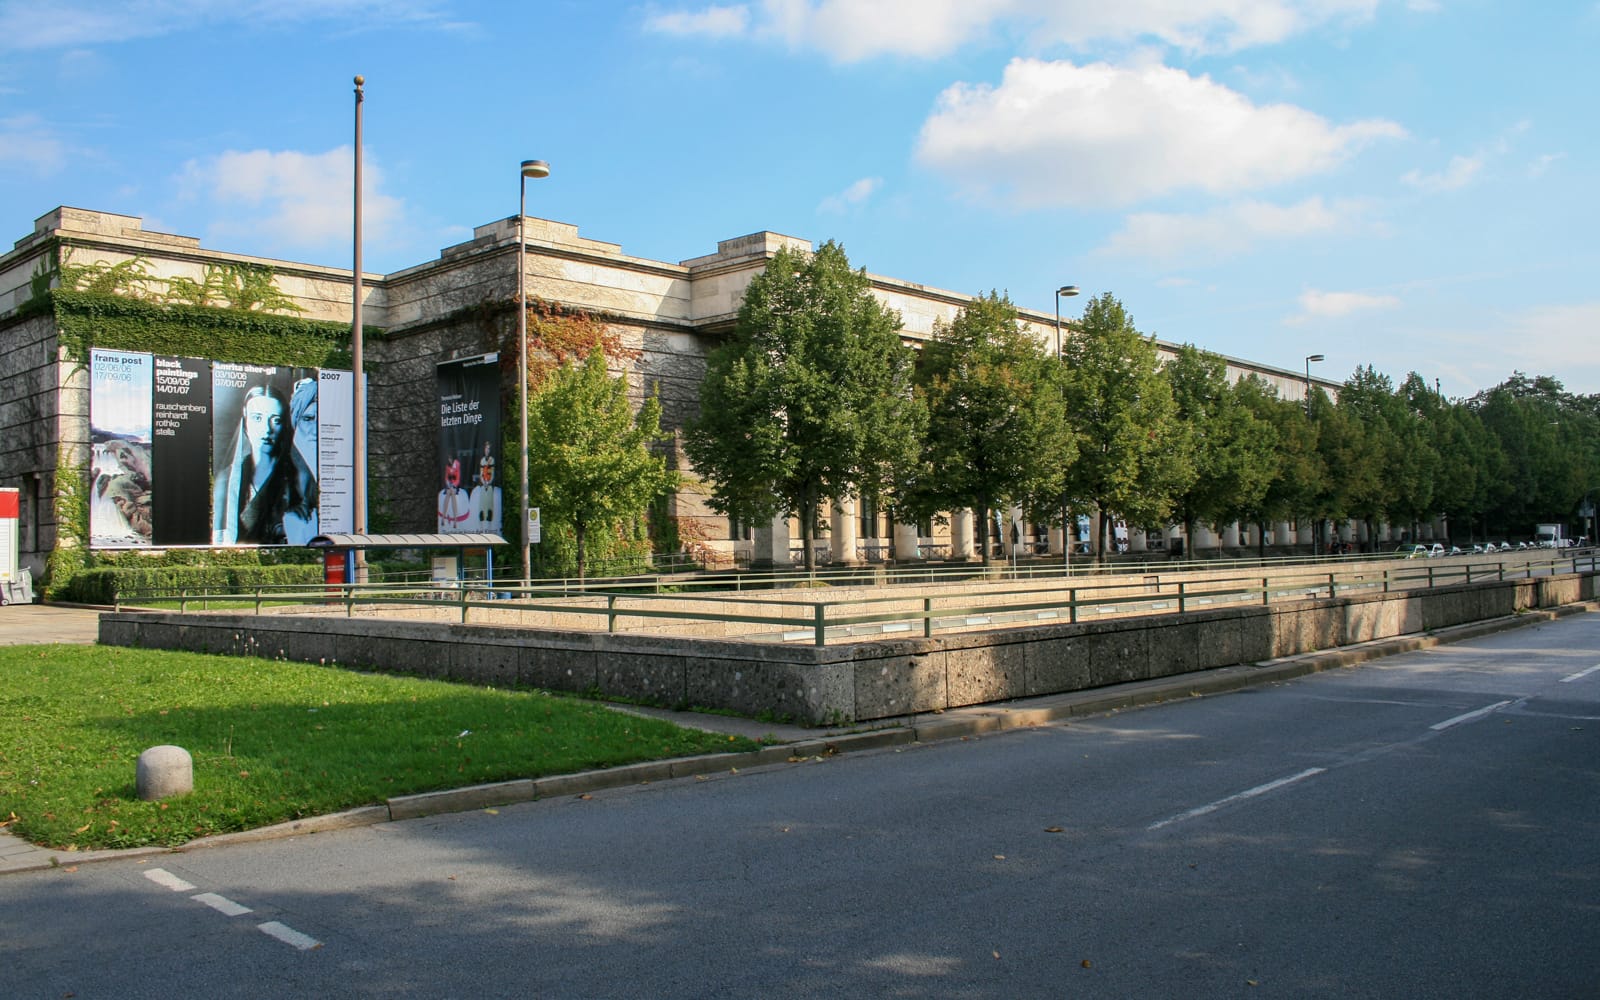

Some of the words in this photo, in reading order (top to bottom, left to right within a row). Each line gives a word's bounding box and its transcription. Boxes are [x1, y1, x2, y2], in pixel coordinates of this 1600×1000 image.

[95, 354, 119, 362] frans
[156, 359, 181, 368] black
[95, 372, 132, 382] 17/09/06
[156, 369, 199, 379] paintings
[214, 370, 247, 380] 03/10/06
[156, 377, 190, 386] 15/09/06
[214, 379, 247, 388] 07/01/07
[156, 385, 190, 394] 14/01/07
[156, 403, 207, 414] rauschenberg
[441, 404, 451, 414] Die
[452, 402, 468, 413] Liste
[469, 400, 480, 411] der
[156, 412, 188, 420] reinhardt
[441, 416, 462, 427] letzten
[463, 413, 483, 425] Dinge
[156, 420, 180, 428] rothko
[156, 428, 175, 436] stella
